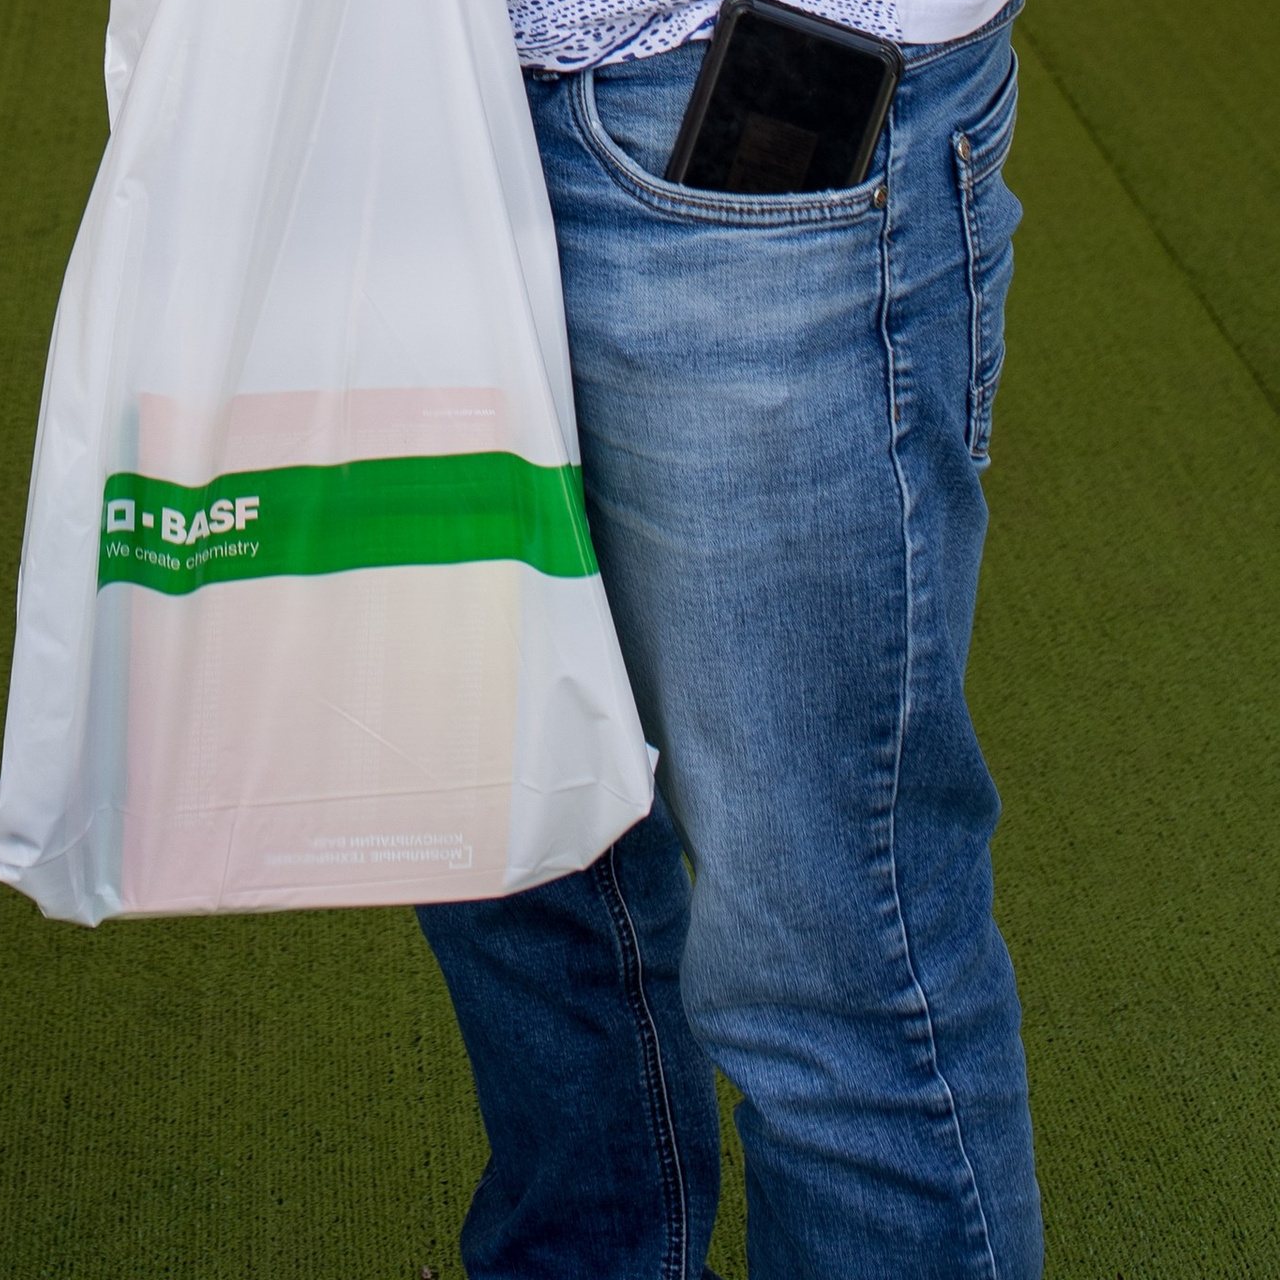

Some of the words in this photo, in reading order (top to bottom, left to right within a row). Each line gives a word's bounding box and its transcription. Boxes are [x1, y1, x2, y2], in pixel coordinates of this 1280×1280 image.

[161, 496, 260, 545] BASF
[106, 541, 130, 558] We
[135, 547, 180, 570] create
[186, 541, 259, 570] chemistry
